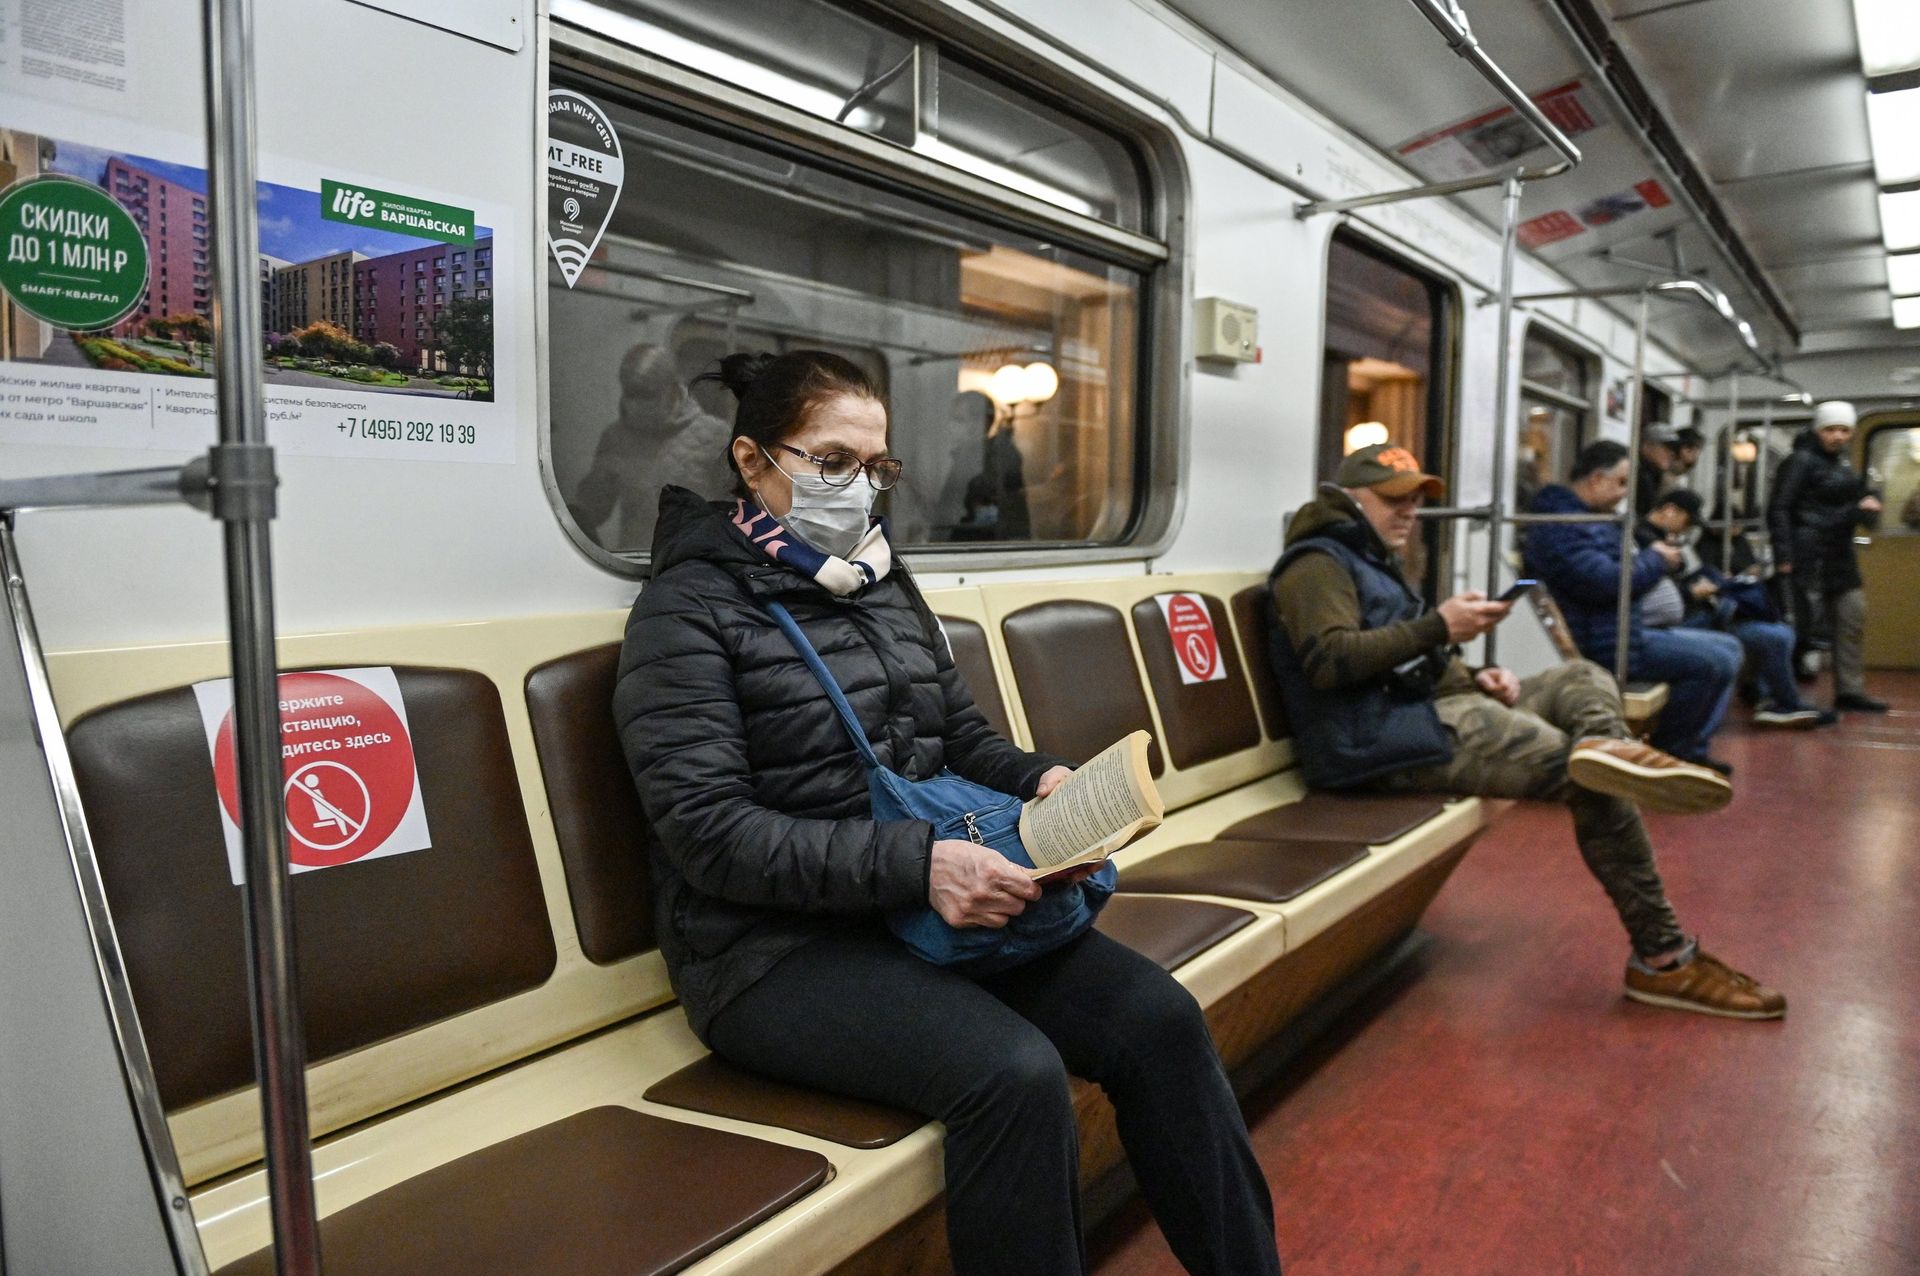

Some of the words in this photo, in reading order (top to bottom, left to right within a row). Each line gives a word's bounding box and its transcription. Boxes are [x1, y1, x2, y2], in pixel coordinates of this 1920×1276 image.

[548, 101, 570, 114] НАЯ
[572, 102, 596, 124] WI-FI
[595, 122, 612, 149] СЕТЬ
[332, 188, 376, 220] life
[381, 201, 405, 212] ЖИЛОЙ
[406, 206, 432, 217] КВАРТАЛ
[21, 202, 109, 240] СКИДКИ
[381, 209, 466, 237] ВАРШАВСКАЯ
[8, 234, 40, 264] ДО
[47, 240, 57, 265] 1
[62, 241, 110, 272] МЛН
[21, 284, 119, 303] SMART-КВАРТАЛ
[40, 380, 82, 391] жилые
[85, 383, 141, 395] кварталы
[165, 387, 217, 400] Интеллек
[8, 394, 22, 403] от
[25, 397, 64, 407] метро
[165, 404, 218, 416] Квартиры
[264, 397, 302, 407] системы
[305, 398, 367, 411] безопасности
[14, 411, 44, 421] сада
[58, 415, 98, 424] школа
[337, 417, 357, 438] +7
[361, 418, 402, 440] (495)
[406, 421, 434, 442] 292
[439, 423, 454, 443] 19
[458, 424, 475, 444] 39
[278, 693, 344, 713] ержите
[280, 713, 361, 734] станцию,
[281, 739, 341, 758] дитесь
[345, 732, 392, 749] здесь
